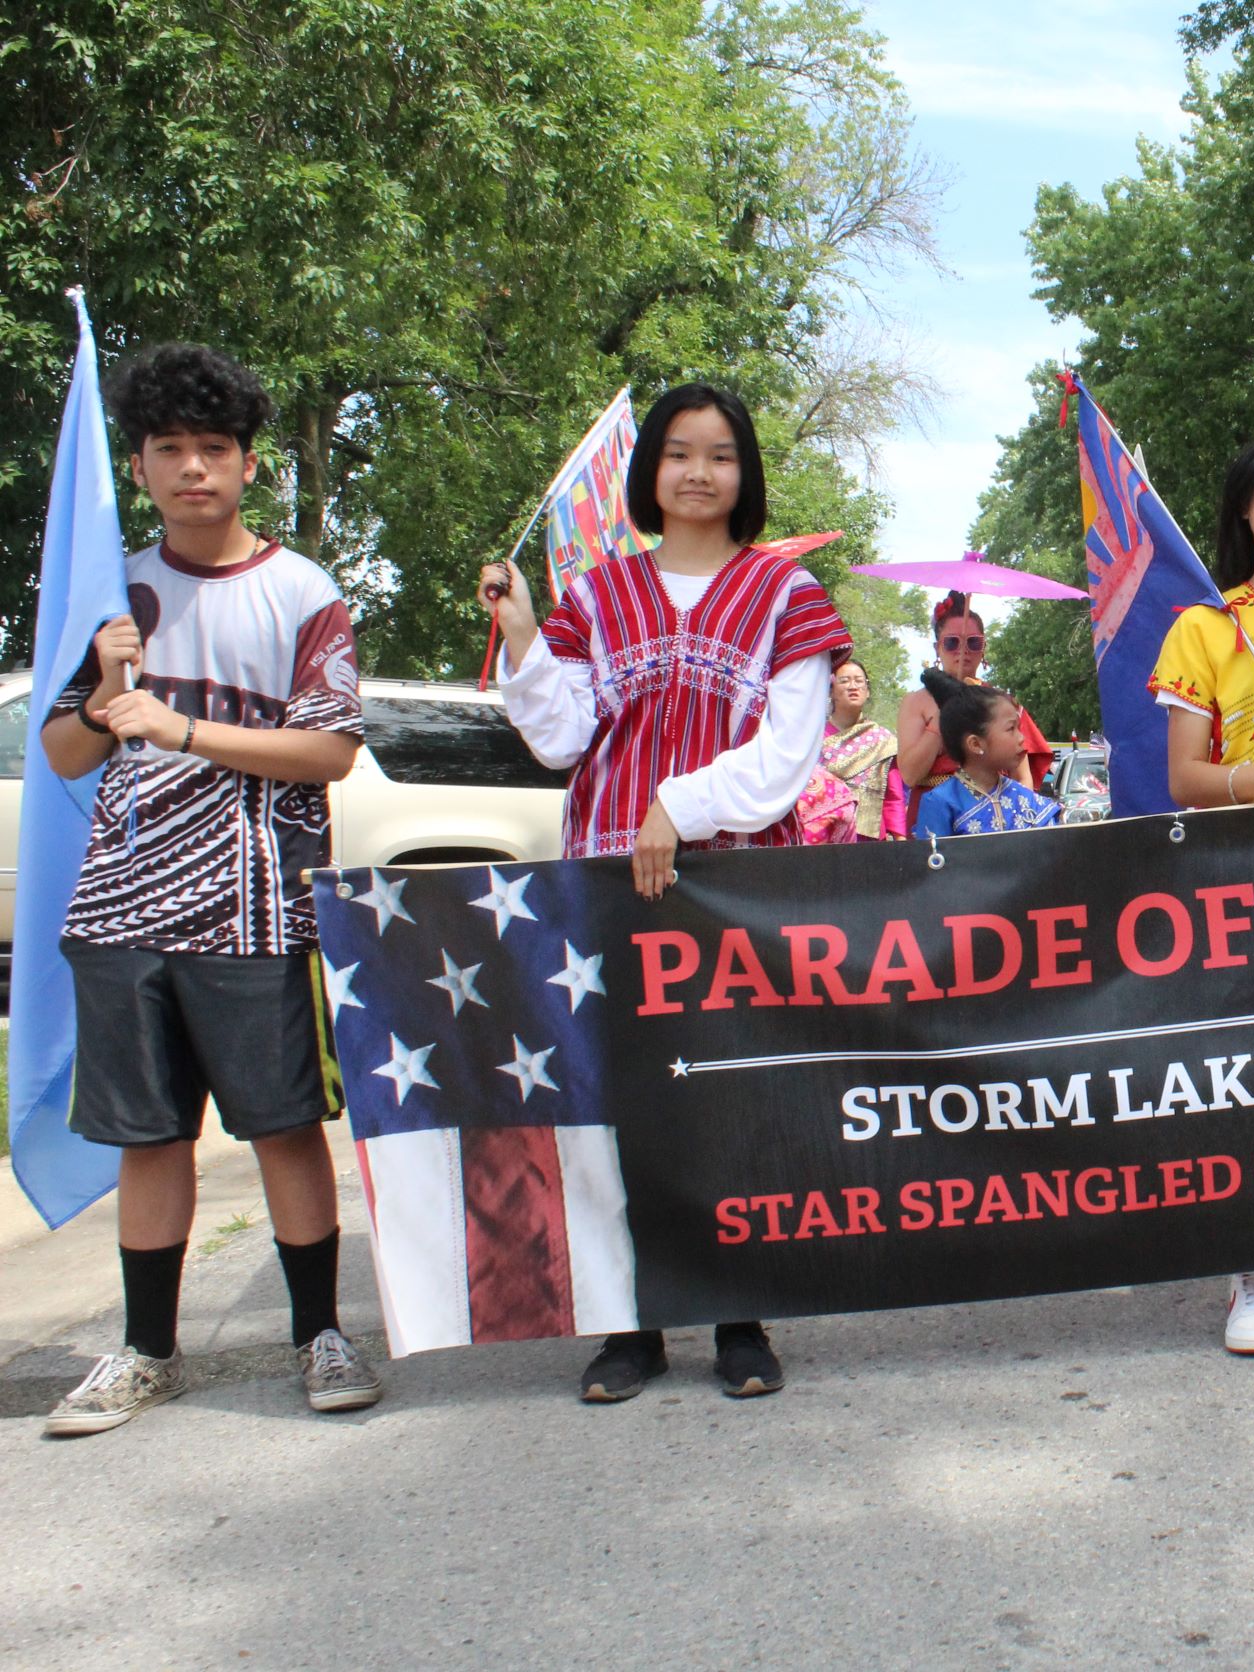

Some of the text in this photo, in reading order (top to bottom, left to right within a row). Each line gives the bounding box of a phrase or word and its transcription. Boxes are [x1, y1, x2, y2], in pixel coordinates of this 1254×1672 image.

[630, 904, 1093, 1017] PARADE
[841, 1072, 1096, 1141] STORM
[715, 1187, 887, 1245] STAR
[899, 1154, 1242, 1231] SPANGLED
